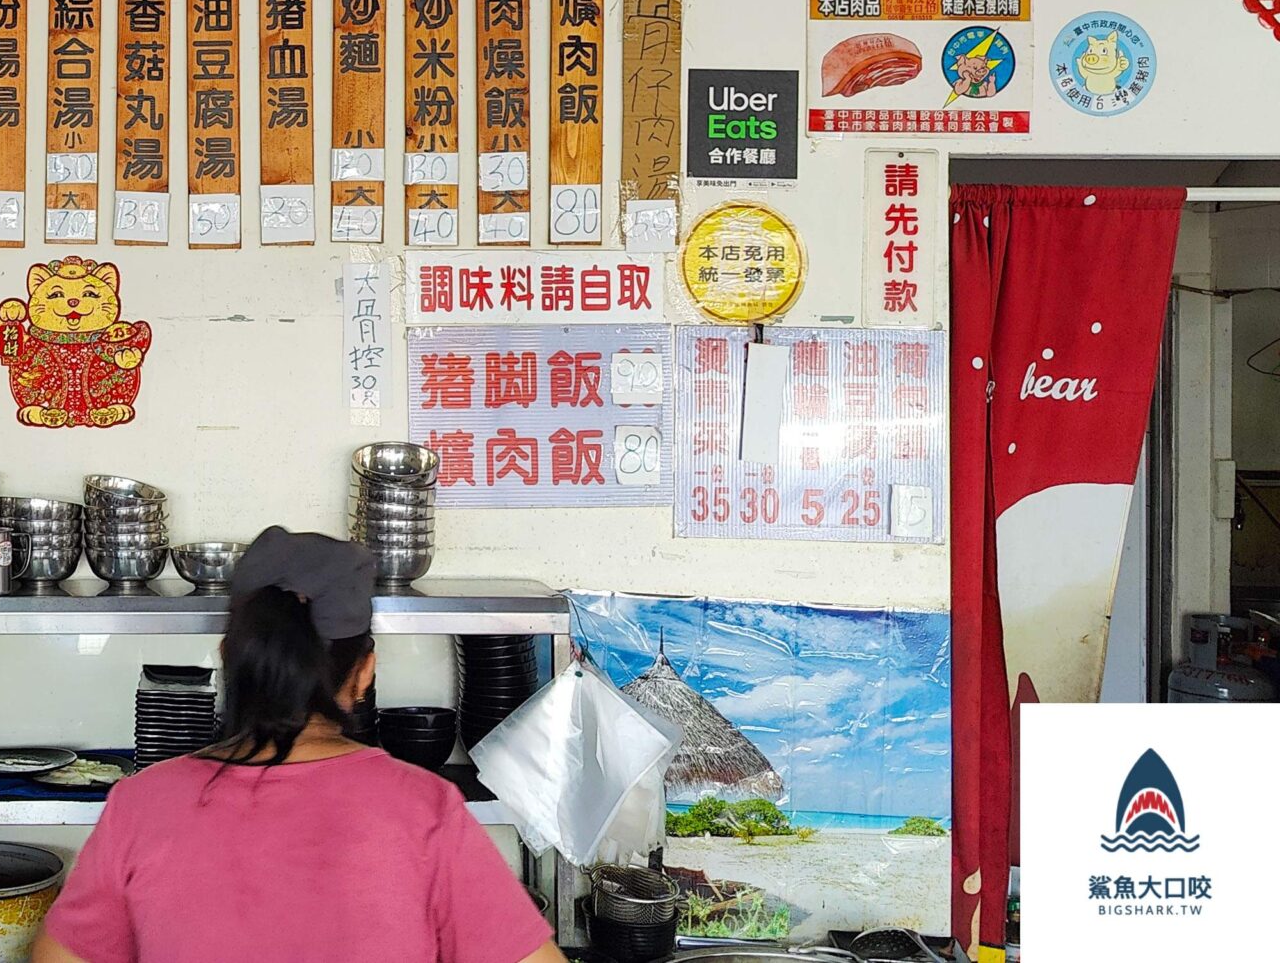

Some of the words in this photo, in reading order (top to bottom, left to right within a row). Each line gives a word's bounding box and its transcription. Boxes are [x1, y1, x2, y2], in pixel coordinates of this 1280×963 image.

[708, 86, 778, 112] Uber
[343, 128, 374, 149] 小
[708, 115, 777, 139] Eats
[64, 132, 83, 149] 小
[417, 133, 448, 153] 小
[490, 133, 522, 153] 小
[708, 147, 777, 165] 合作餐廳
[488, 155, 525, 189] 30
[61, 190, 81, 209] 大
[345, 185, 377, 206] 大
[418, 190, 448, 210] 大
[492, 190, 523, 210] 大
[335, 207, 378, 240] 40
[413, 211, 454, 238] 40
[554, 188, 598, 235] 80
[883, 164, 919, 313] 請先付款
[698, 245, 786, 261] 本店免用
[698, 266, 786, 284] 統一發票
[420, 264, 653, 313] 調味料請自取
[617, 358, 658, 391] 90
[1020, 362, 1098, 401] bear
[619, 434, 658, 474] 80
[691, 486, 730, 522] 35
[740, 487, 779, 523] 30
[801, 488, 825, 526] 5
[841, 489, 881, 526] 25
